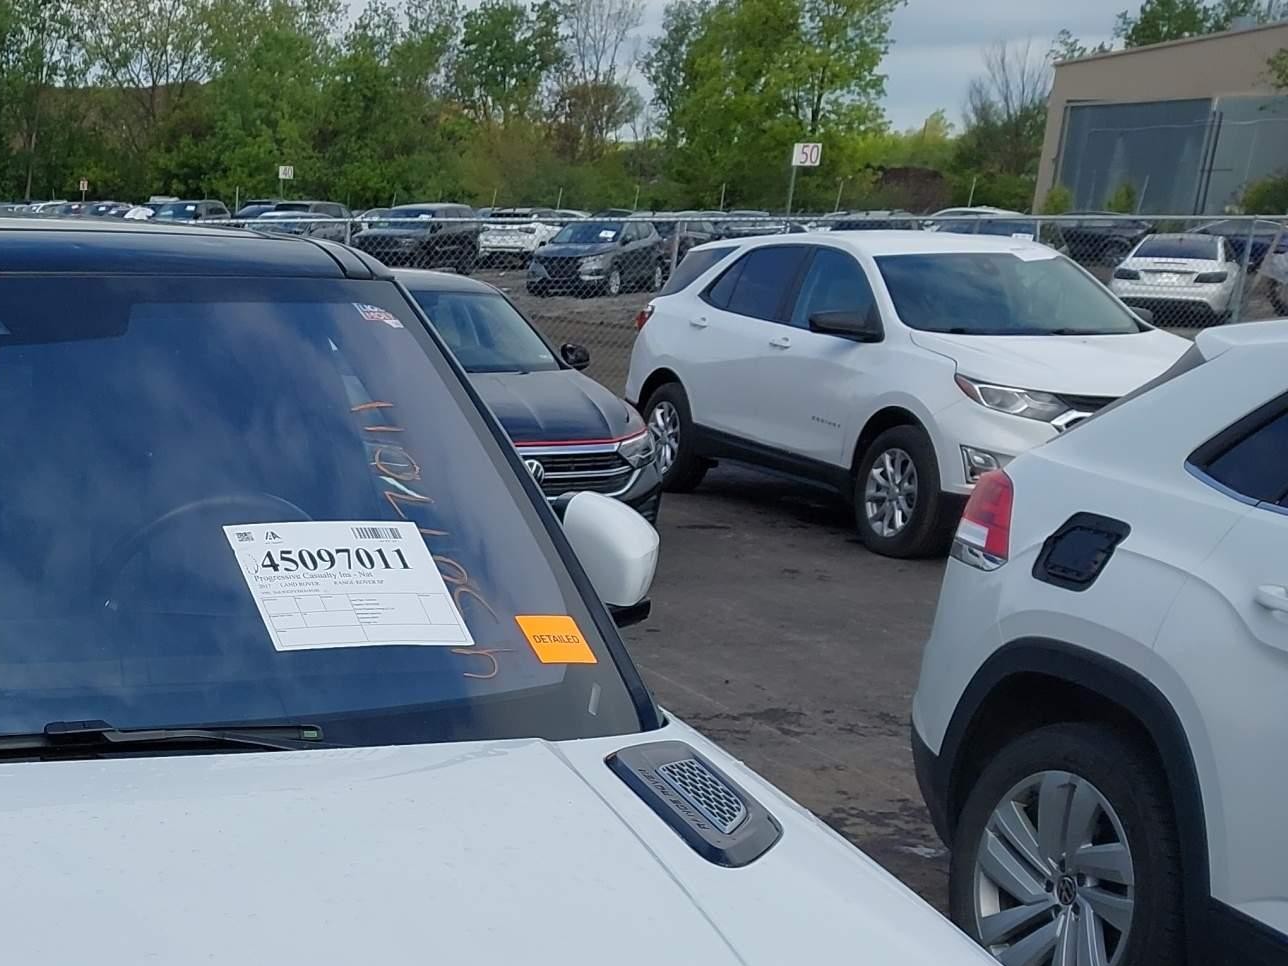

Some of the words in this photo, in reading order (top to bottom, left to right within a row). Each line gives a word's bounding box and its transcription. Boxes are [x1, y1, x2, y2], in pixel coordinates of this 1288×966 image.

[799, 144, 819, 164] 50
[261, 547, 413, 572] 45097011
[254, 573, 301, 582] Progressive
[302, 571, 337, 580] Casualty
[532, 635, 580, 644] DETAILED
